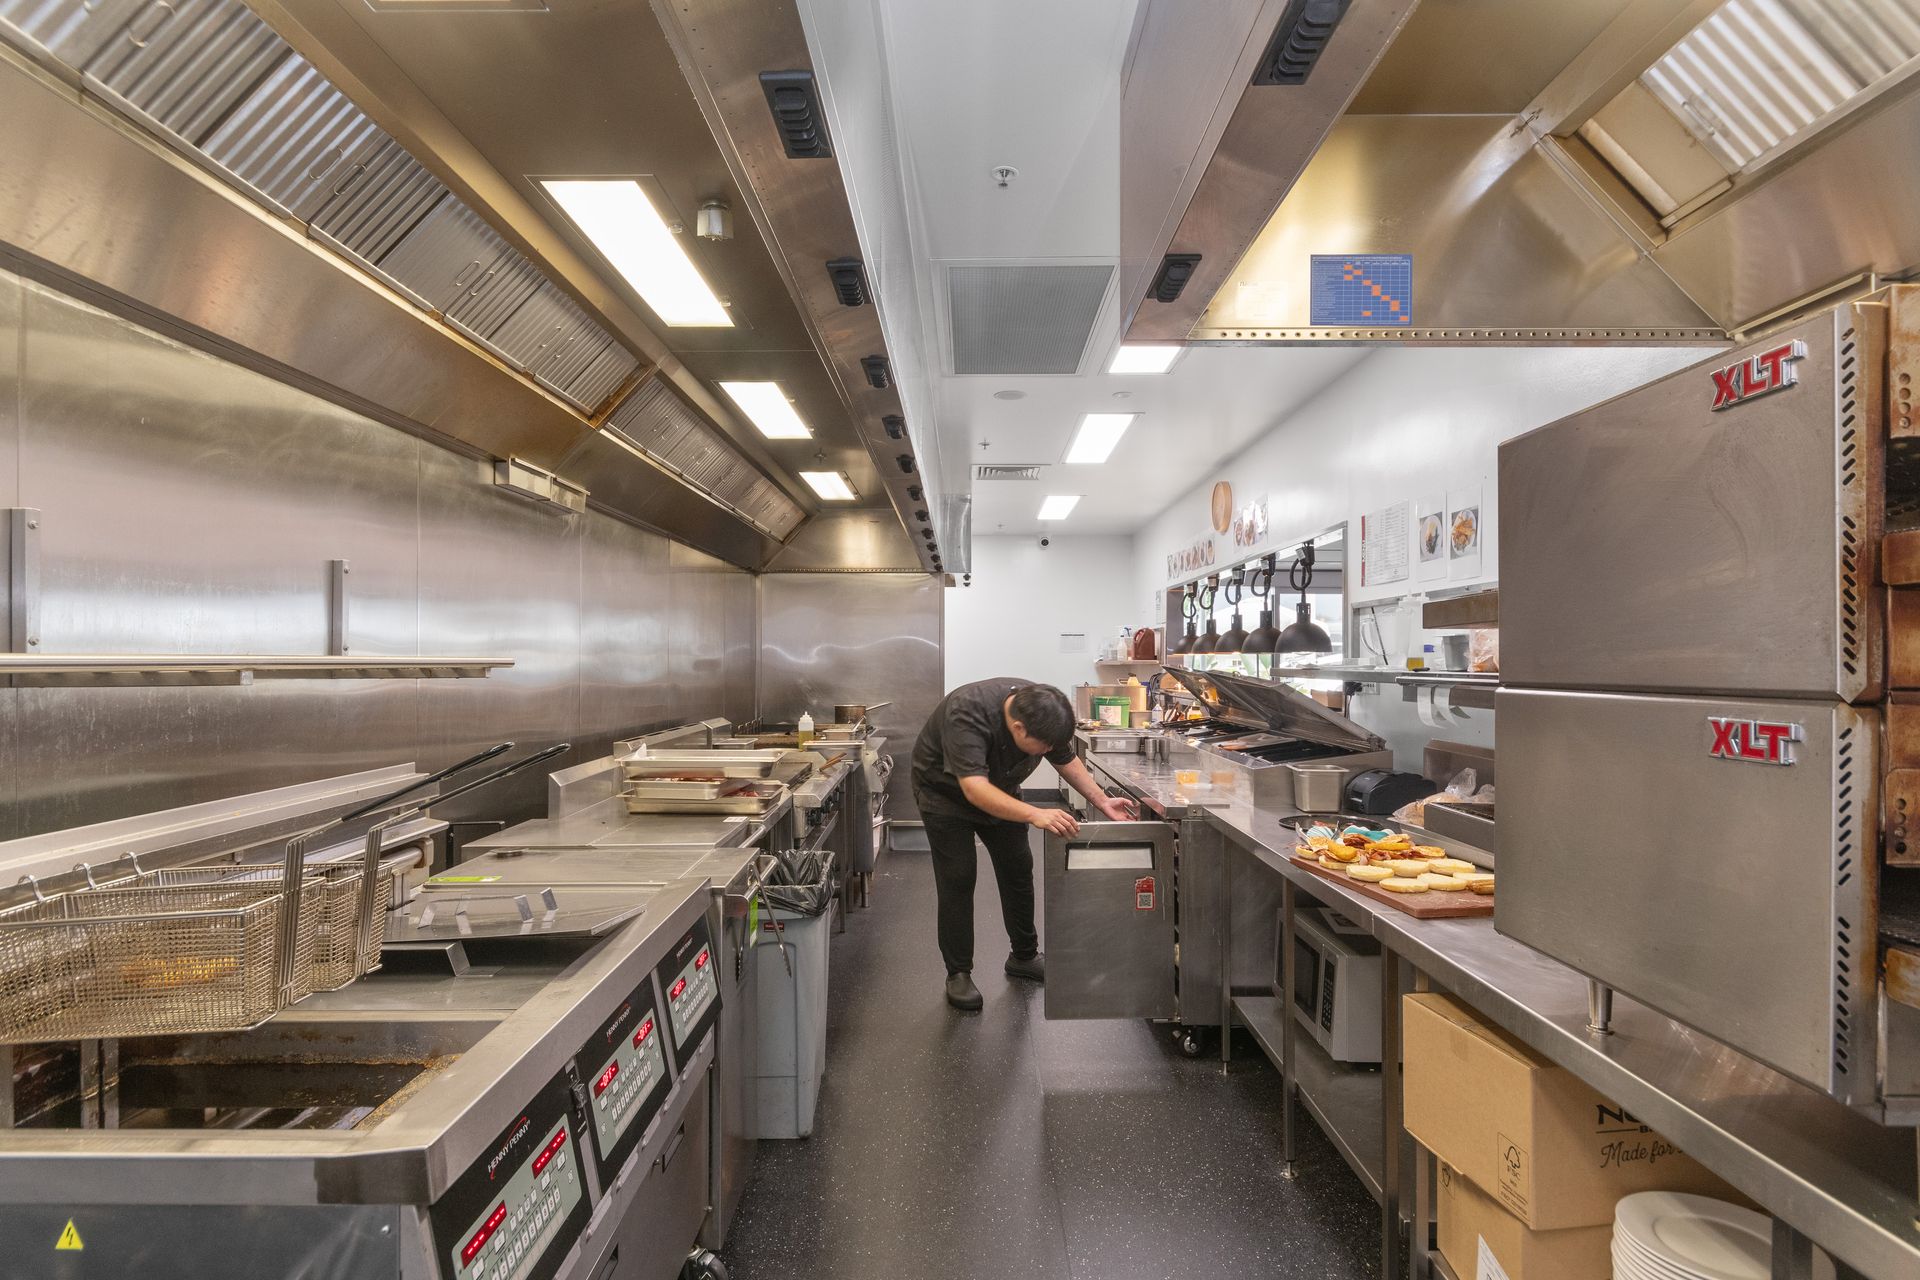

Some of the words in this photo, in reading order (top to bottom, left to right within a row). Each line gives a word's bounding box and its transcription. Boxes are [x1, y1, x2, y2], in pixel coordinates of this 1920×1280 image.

[1710, 339, 1807, 412] XLT
[1707, 717, 1806, 765] XLT
[488, 1144, 509, 1173] HENNY
[509, 1122, 529, 1148] PENNY
[1600, 1141, 1648, 1168] Made
[1650, 1141, 1674, 1163] for
